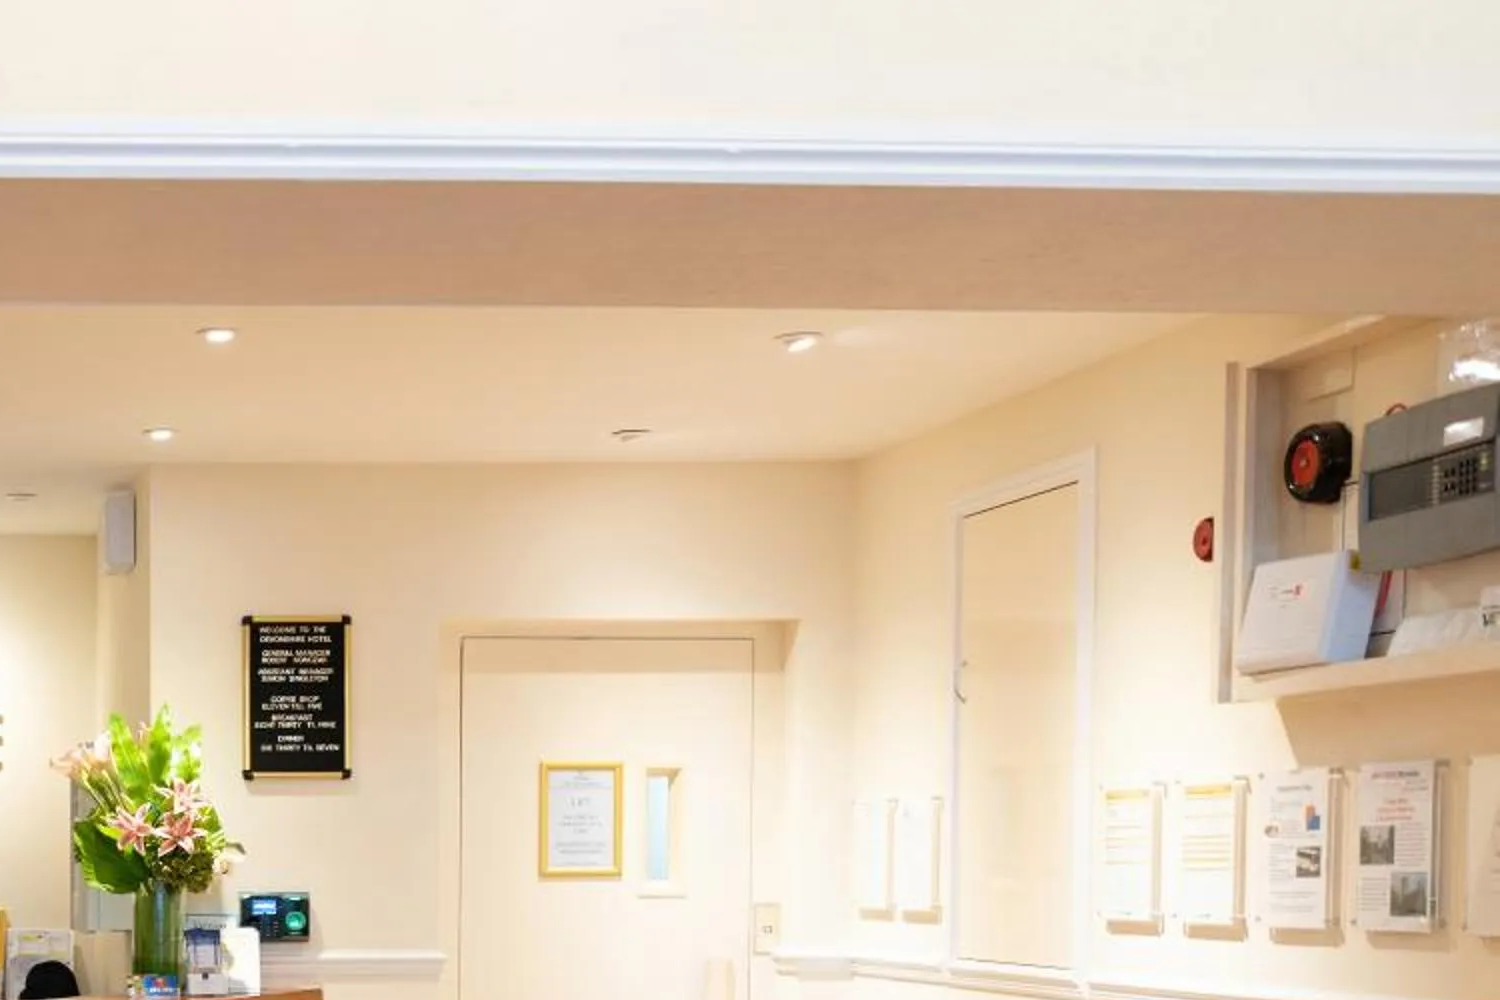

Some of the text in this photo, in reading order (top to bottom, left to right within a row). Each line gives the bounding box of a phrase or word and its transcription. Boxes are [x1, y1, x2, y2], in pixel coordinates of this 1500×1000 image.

[259, 635, 332, 643] DEVONSHIRE HOTEL
[262, 649, 330, 657] GENERAL MANAGER
[270, 695, 320, 703] COFFEE SHOP
[261, 703, 290, 711] ELEVEN
[307, 703, 323, 711] FIVE
[271, 713, 313, 721] BREAKFAST
[254, 721, 276, 729] EIGHT
[278, 721, 303, 729] THIRTY
[275, 744, 301, 752] THIRTY
[315, 744, 340, 752] SEVEN
